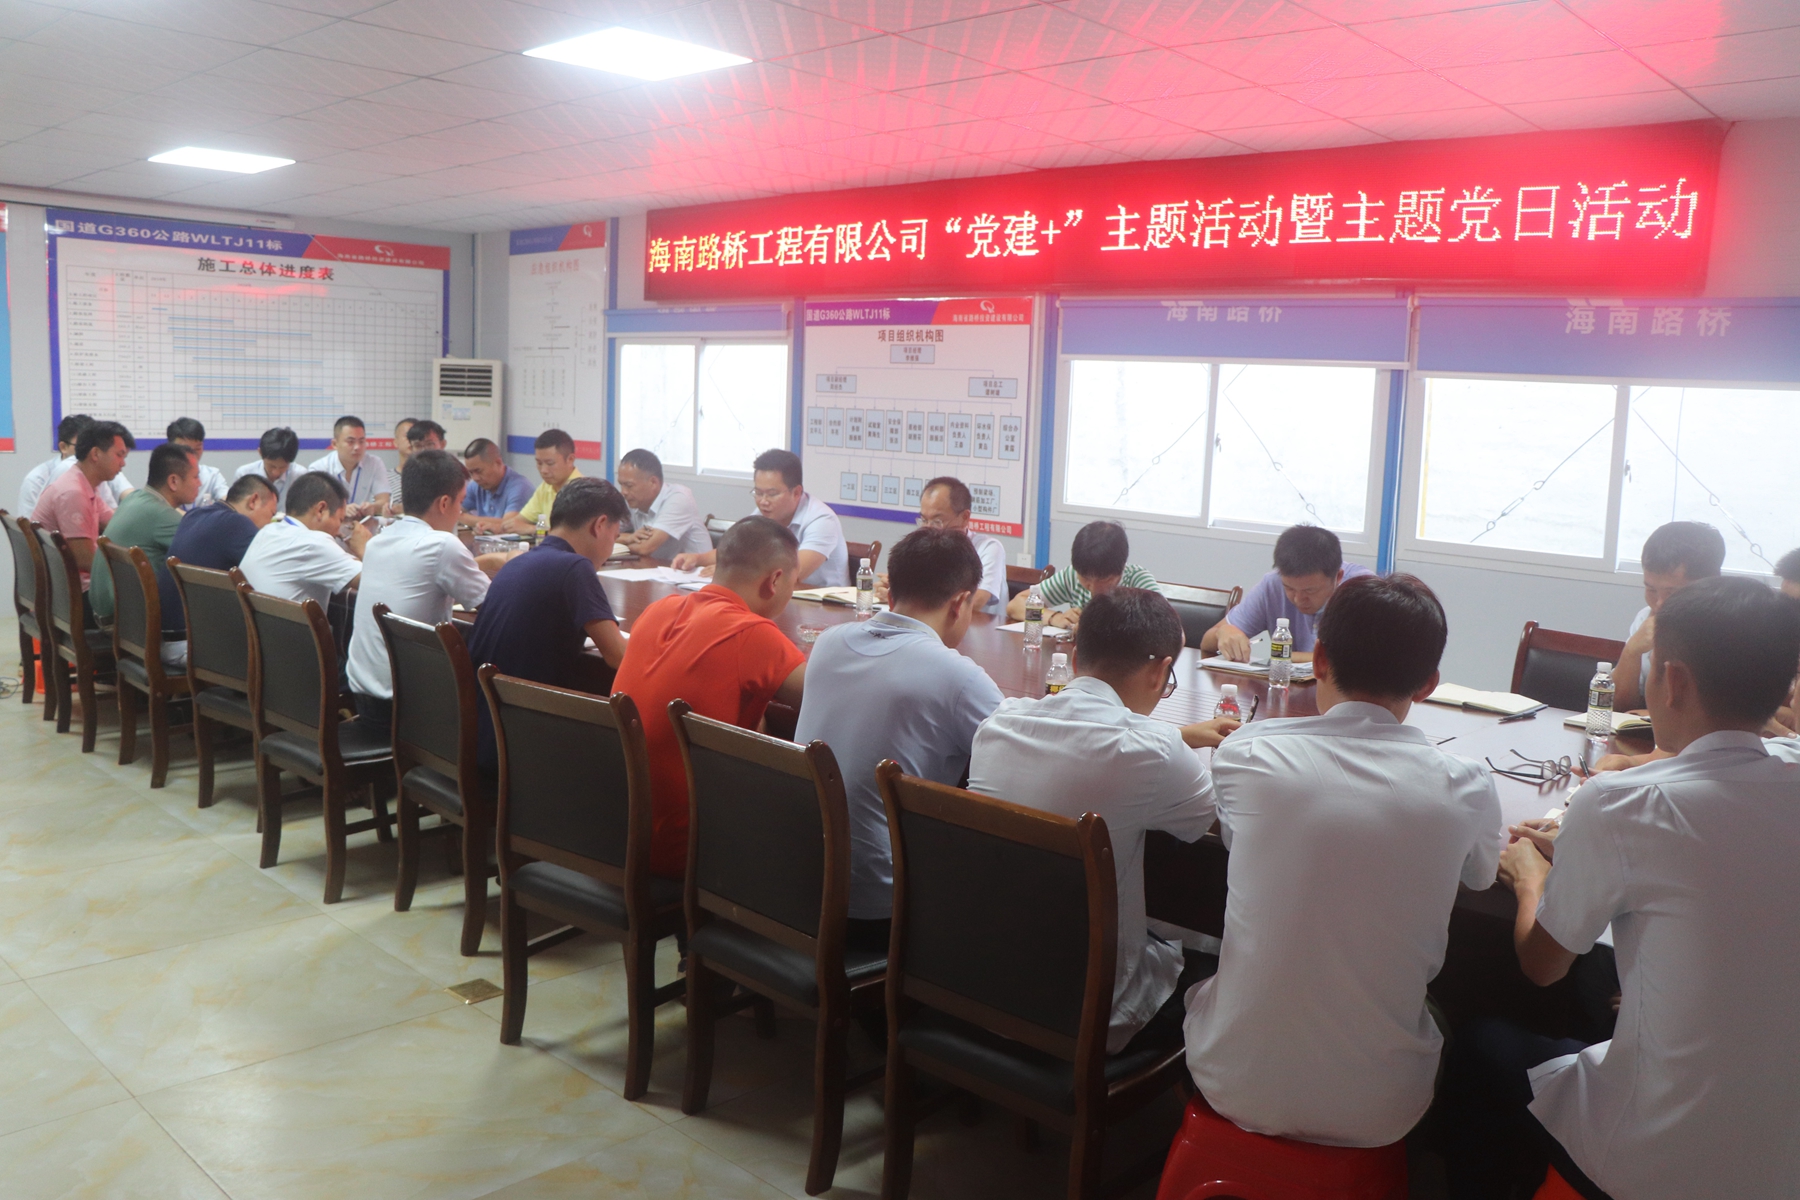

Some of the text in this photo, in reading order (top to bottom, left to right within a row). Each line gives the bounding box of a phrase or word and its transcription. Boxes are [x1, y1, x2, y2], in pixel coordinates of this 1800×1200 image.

[55, 220, 283, 250] 国道G360公路WLTJ11标
[197, 257, 335, 280] 施工总体进度表
[806, 308, 890, 321] 国道G360公路WLTJ11标
[1565, 305, 1732, 337] 海南路桥
[878, 329, 944, 342] 项目组织机构图
[843, 483, 855, 491] 一工区
[864, 485, 877, 493] 二工区
[884, 487, 897, 495] 三工区
